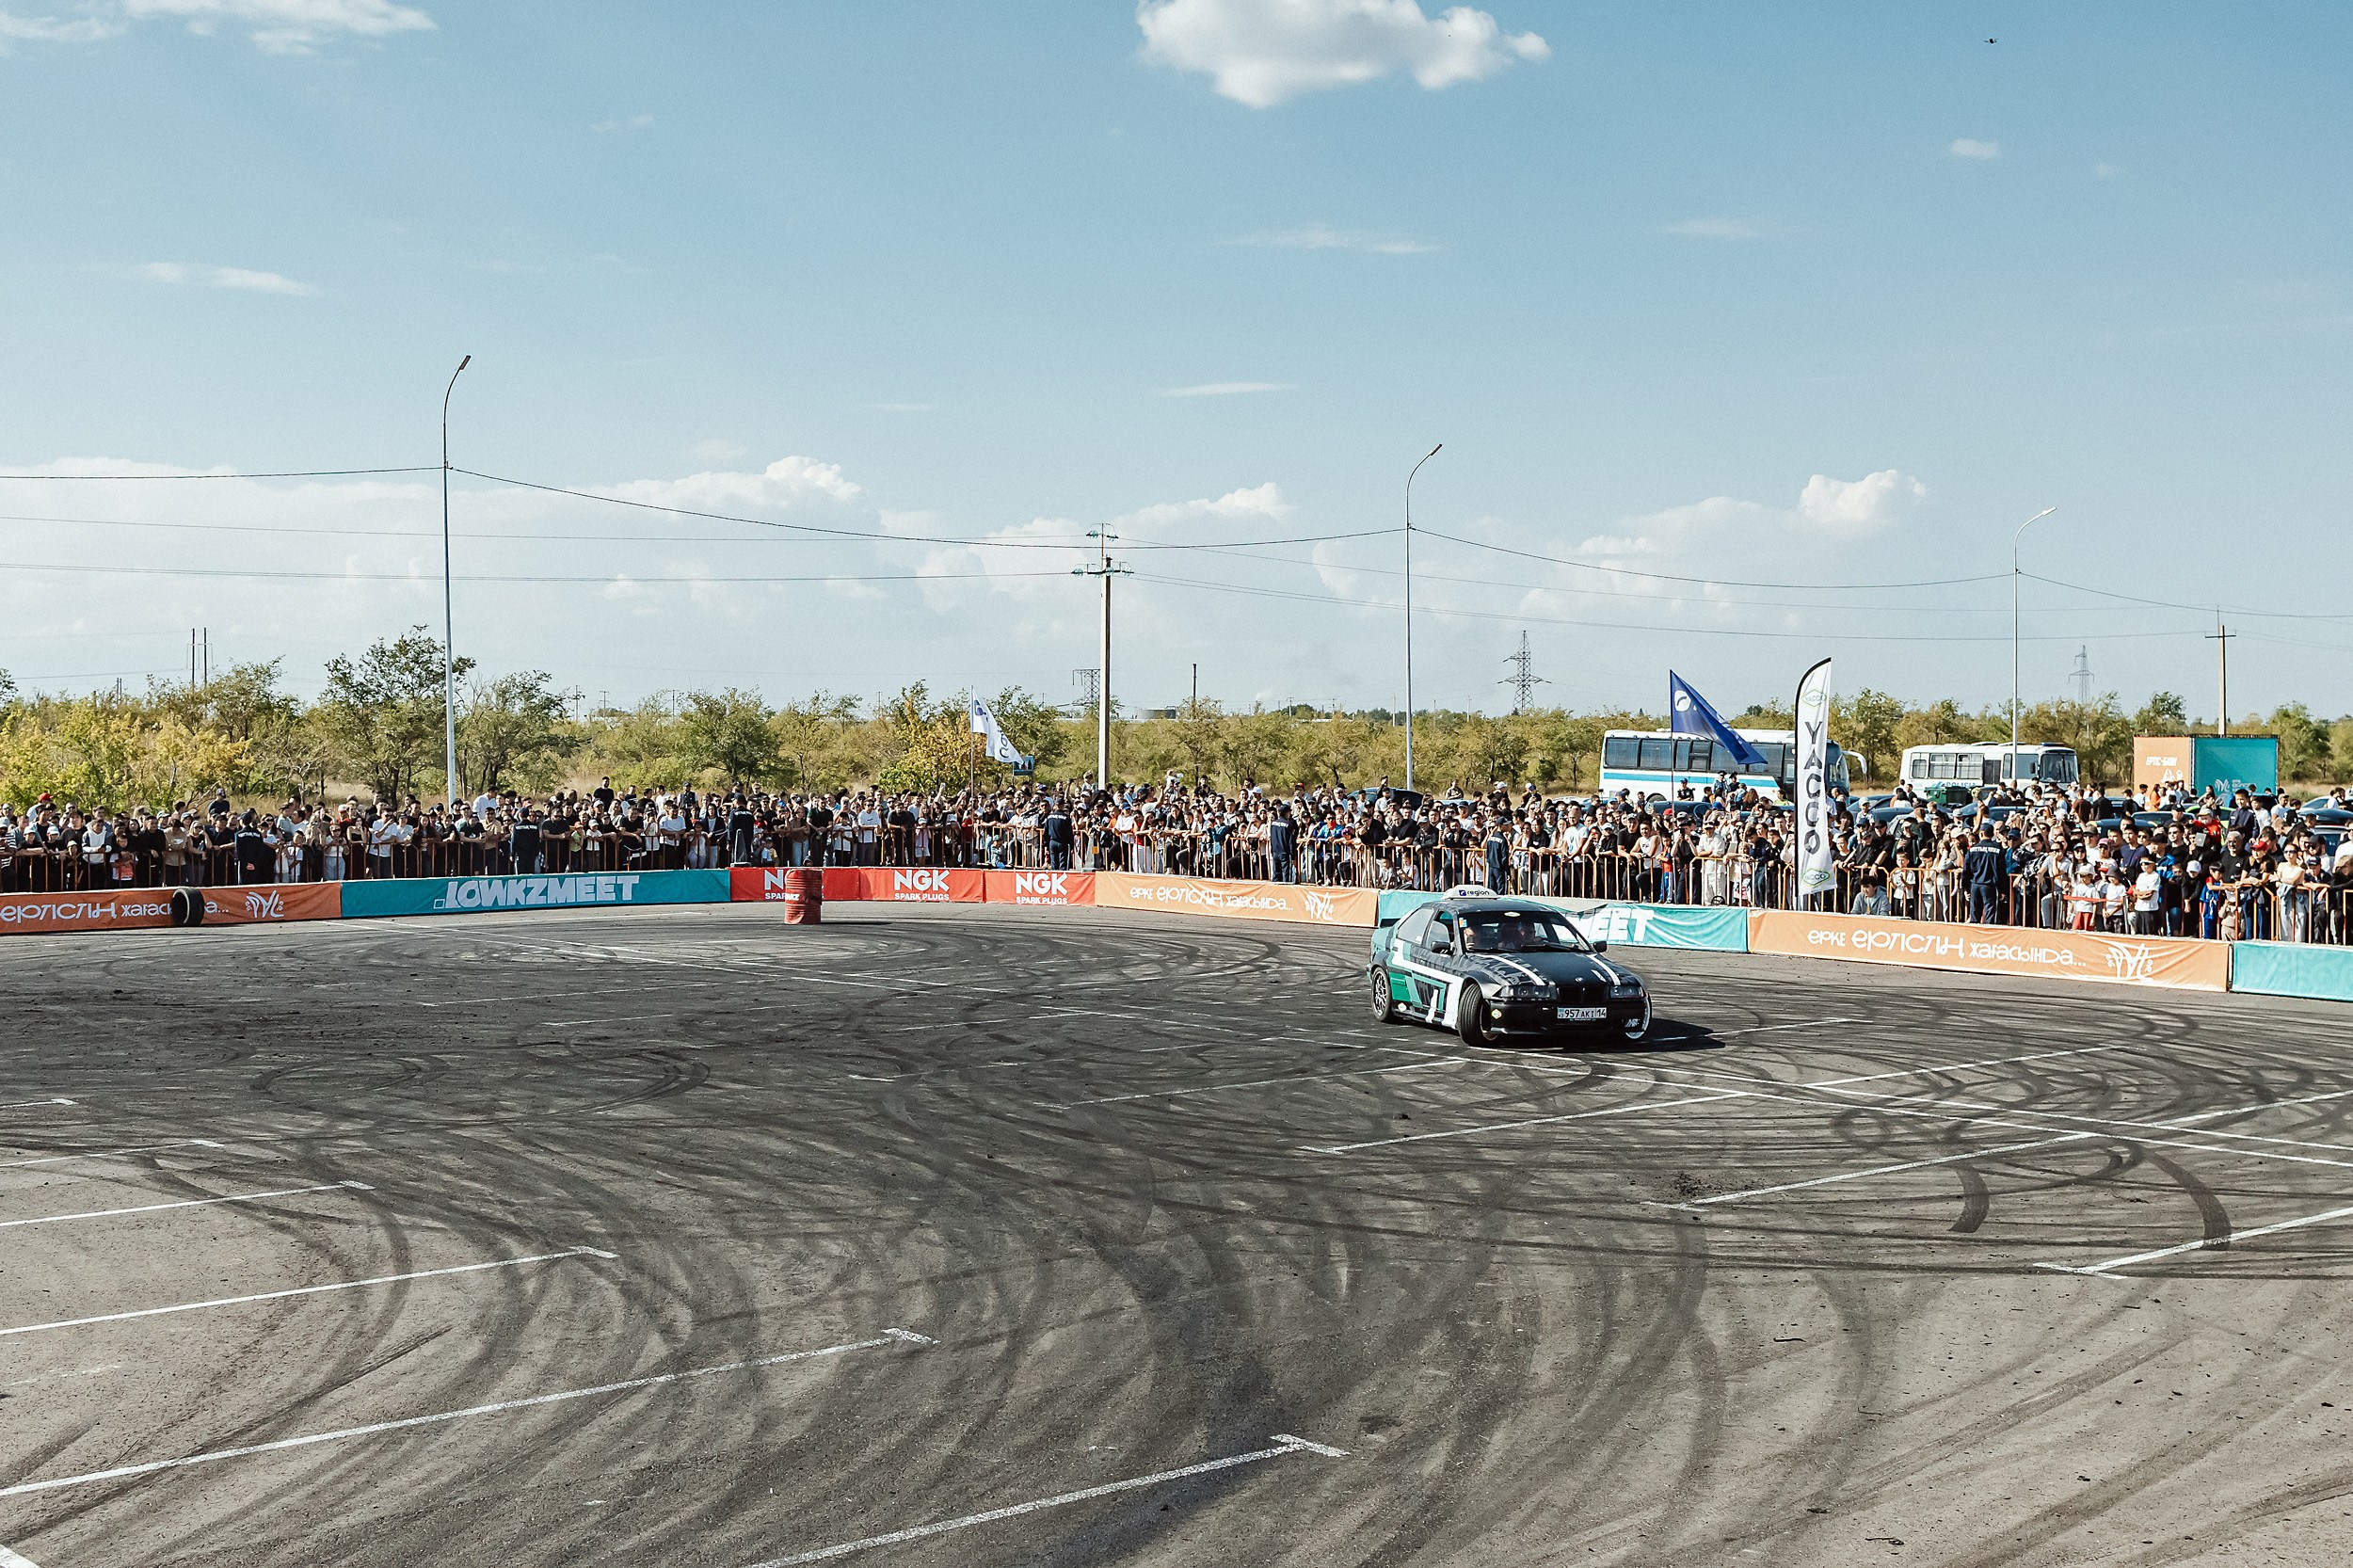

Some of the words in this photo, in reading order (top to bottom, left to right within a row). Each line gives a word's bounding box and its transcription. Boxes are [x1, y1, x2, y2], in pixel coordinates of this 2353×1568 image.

[1803, 721, 1823, 856] YACCO
[894, 869, 951, 892] NGK
[1016, 872, 1068, 896] NGK
[894, 892, 921, 901] SPARK
[1016, 896, 1042, 904] SPARK
[1564, 1009, 1579, 1017] 957
[1596, 1009, 1606, 1017] 14
